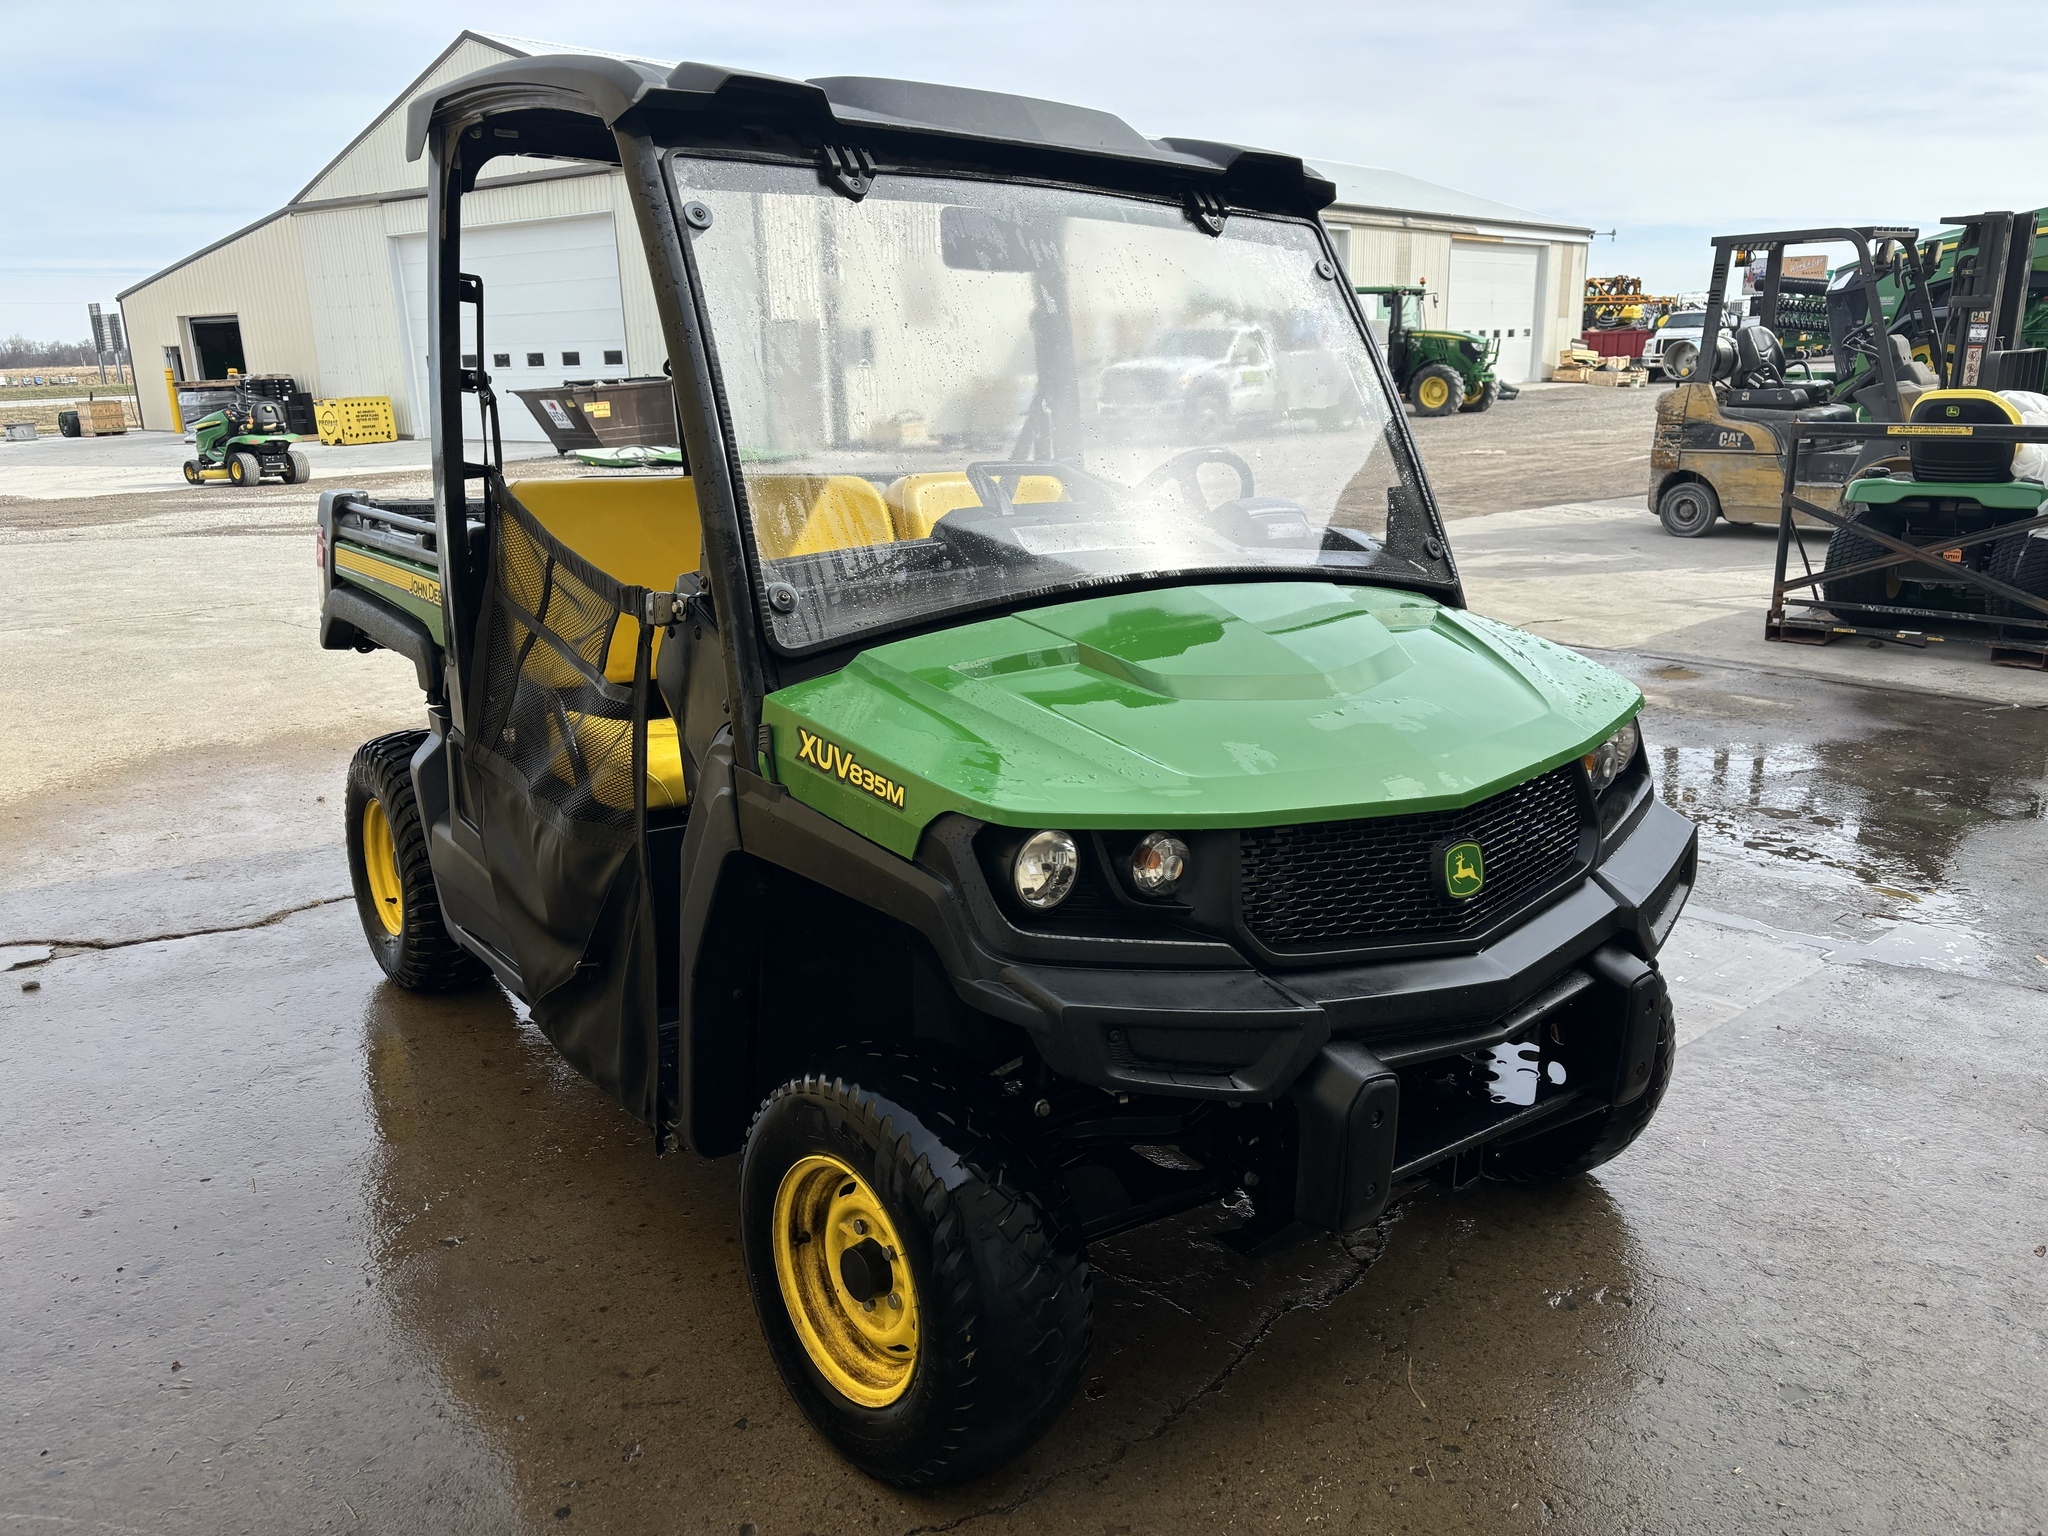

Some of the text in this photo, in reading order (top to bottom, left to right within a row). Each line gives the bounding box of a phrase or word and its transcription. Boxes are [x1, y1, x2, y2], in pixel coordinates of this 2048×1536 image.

[1971, 311, 1991, 323] CAT
[1719, 431, 1744, 448] CAT
[409, 576, 428, 600] JOHN
[798, 727, 906, 809] XUV835M
